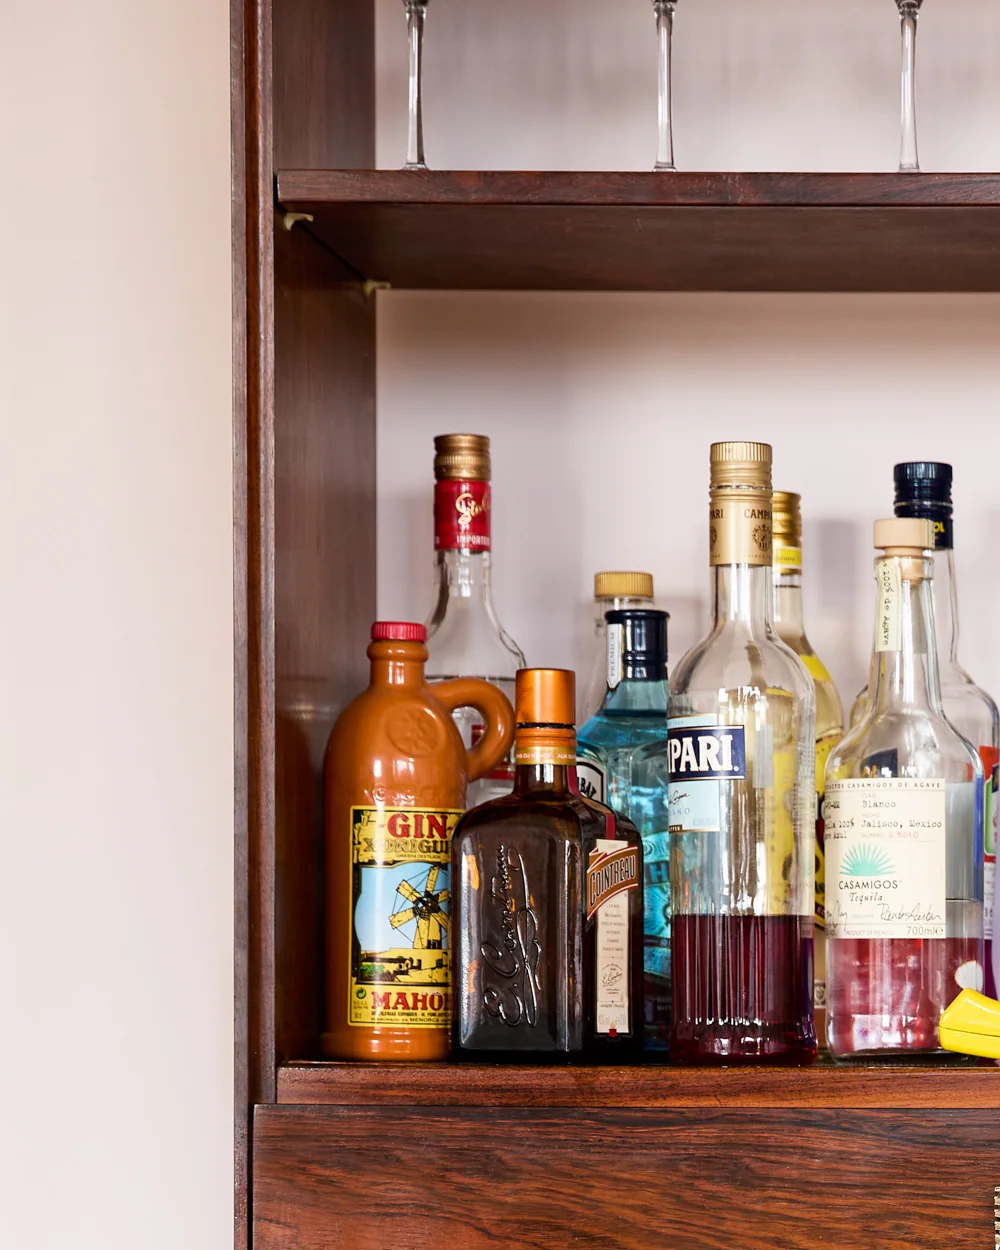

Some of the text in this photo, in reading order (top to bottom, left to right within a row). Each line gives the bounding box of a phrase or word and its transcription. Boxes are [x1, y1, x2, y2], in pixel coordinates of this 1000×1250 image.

[862, 800, 897, 808] Blanco
[861, 819, 943, 829] Jalisco, Mexico
[589, 854, 636, 907] COINTREAU
[839, 880, 898, 889] CASAMIGOS
[849, 892, 883, 904] Tequila
